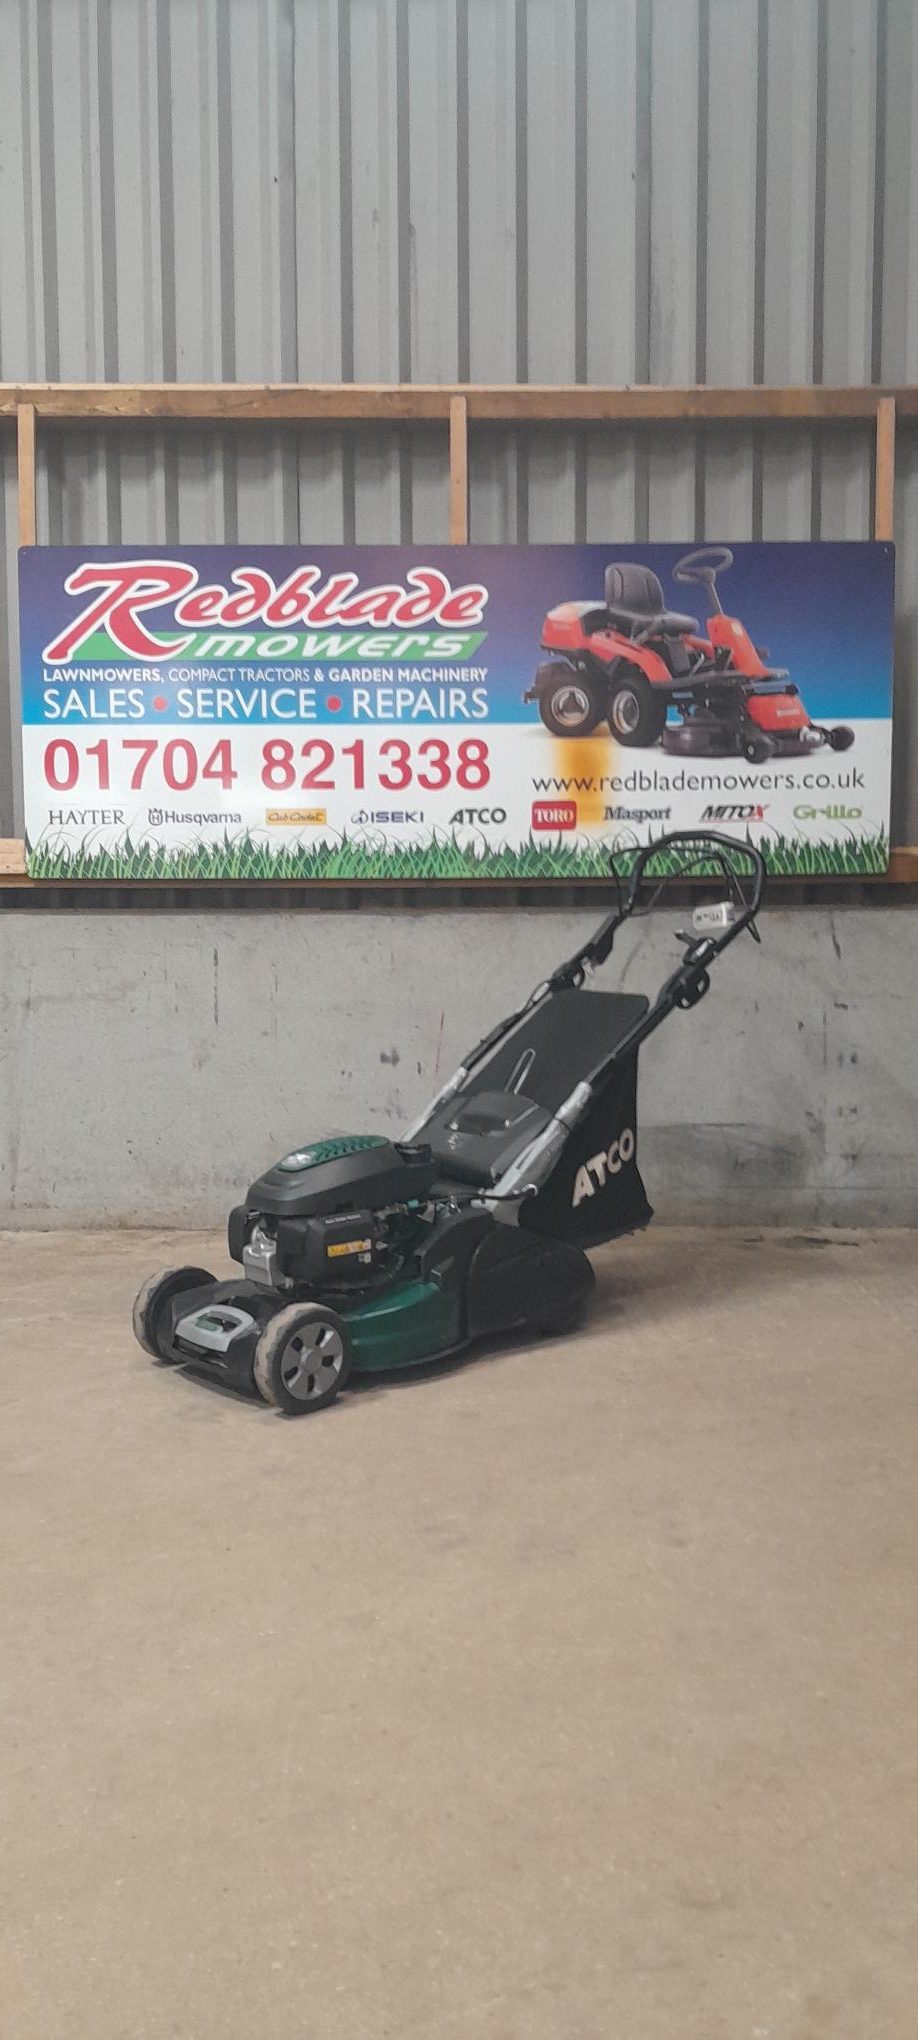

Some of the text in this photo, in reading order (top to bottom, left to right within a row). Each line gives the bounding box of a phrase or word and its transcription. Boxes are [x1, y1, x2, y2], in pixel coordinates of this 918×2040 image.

[43, 560, 488, 664] Redblade
[196, 632, 473, 657] mowers
[43, 667, 488, 683] LAWNMOWERS, COMPACT TRACTORS & GARDEN MACHINERY
[43, 687, 489, 719] SALES SERVICE REPAIRS
[43, 739, 491, 790] 01704 821338
[531, 767, 866, 793] www.redblademowers.co.uk
[49, 810, 125, 825] HAYTER
[164, 810, 242, 826] Husqvarna
[371, 811, 424, 823] ISEKI
[449, 808, 507, 824] ATCO
[535, 808, 574, 822] TORO
[603, 806, 671, 823] Masport
[701, 805, 769, 820] MITOX
[572, 1128, 634, 1208] ATCO
